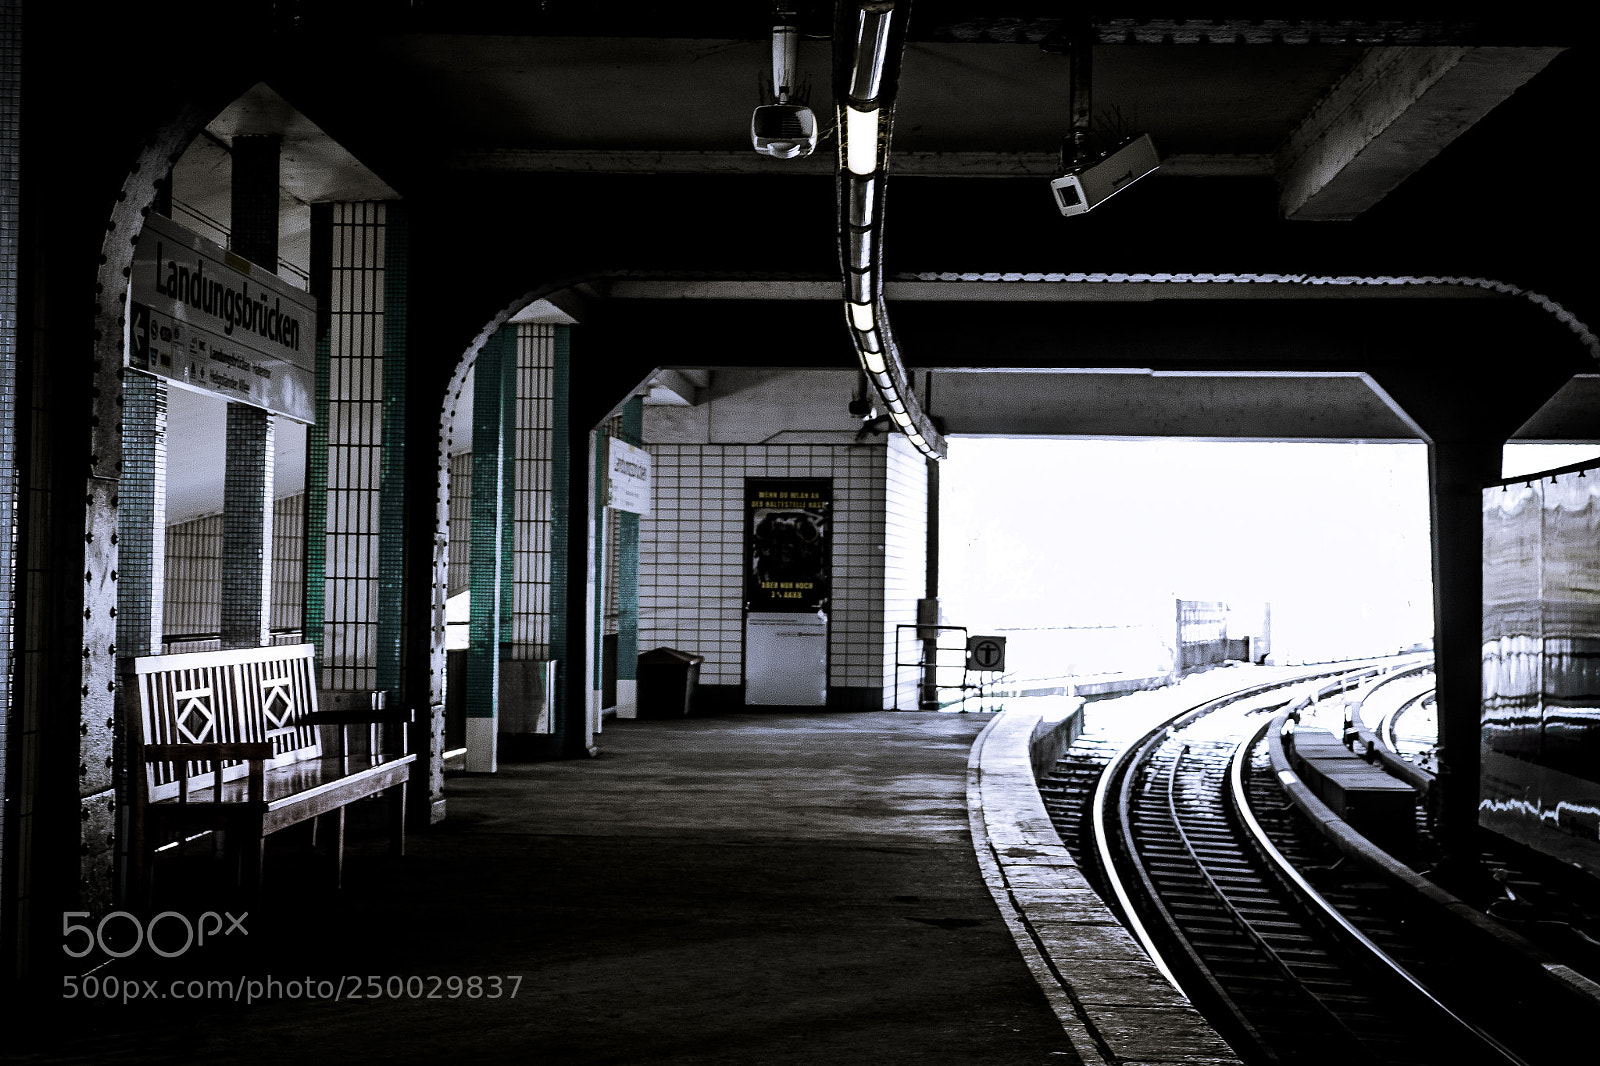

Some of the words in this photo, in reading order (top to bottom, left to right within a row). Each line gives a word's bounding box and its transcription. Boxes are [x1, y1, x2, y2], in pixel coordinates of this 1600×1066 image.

[156, 242, 300, 351] Landungsbrücken
[758, 491, 778, 499] WENN
[779, 491, 789, 499] DU
[751, 500, 764, 508] DER
[761, 581, 779, 589] ABER
